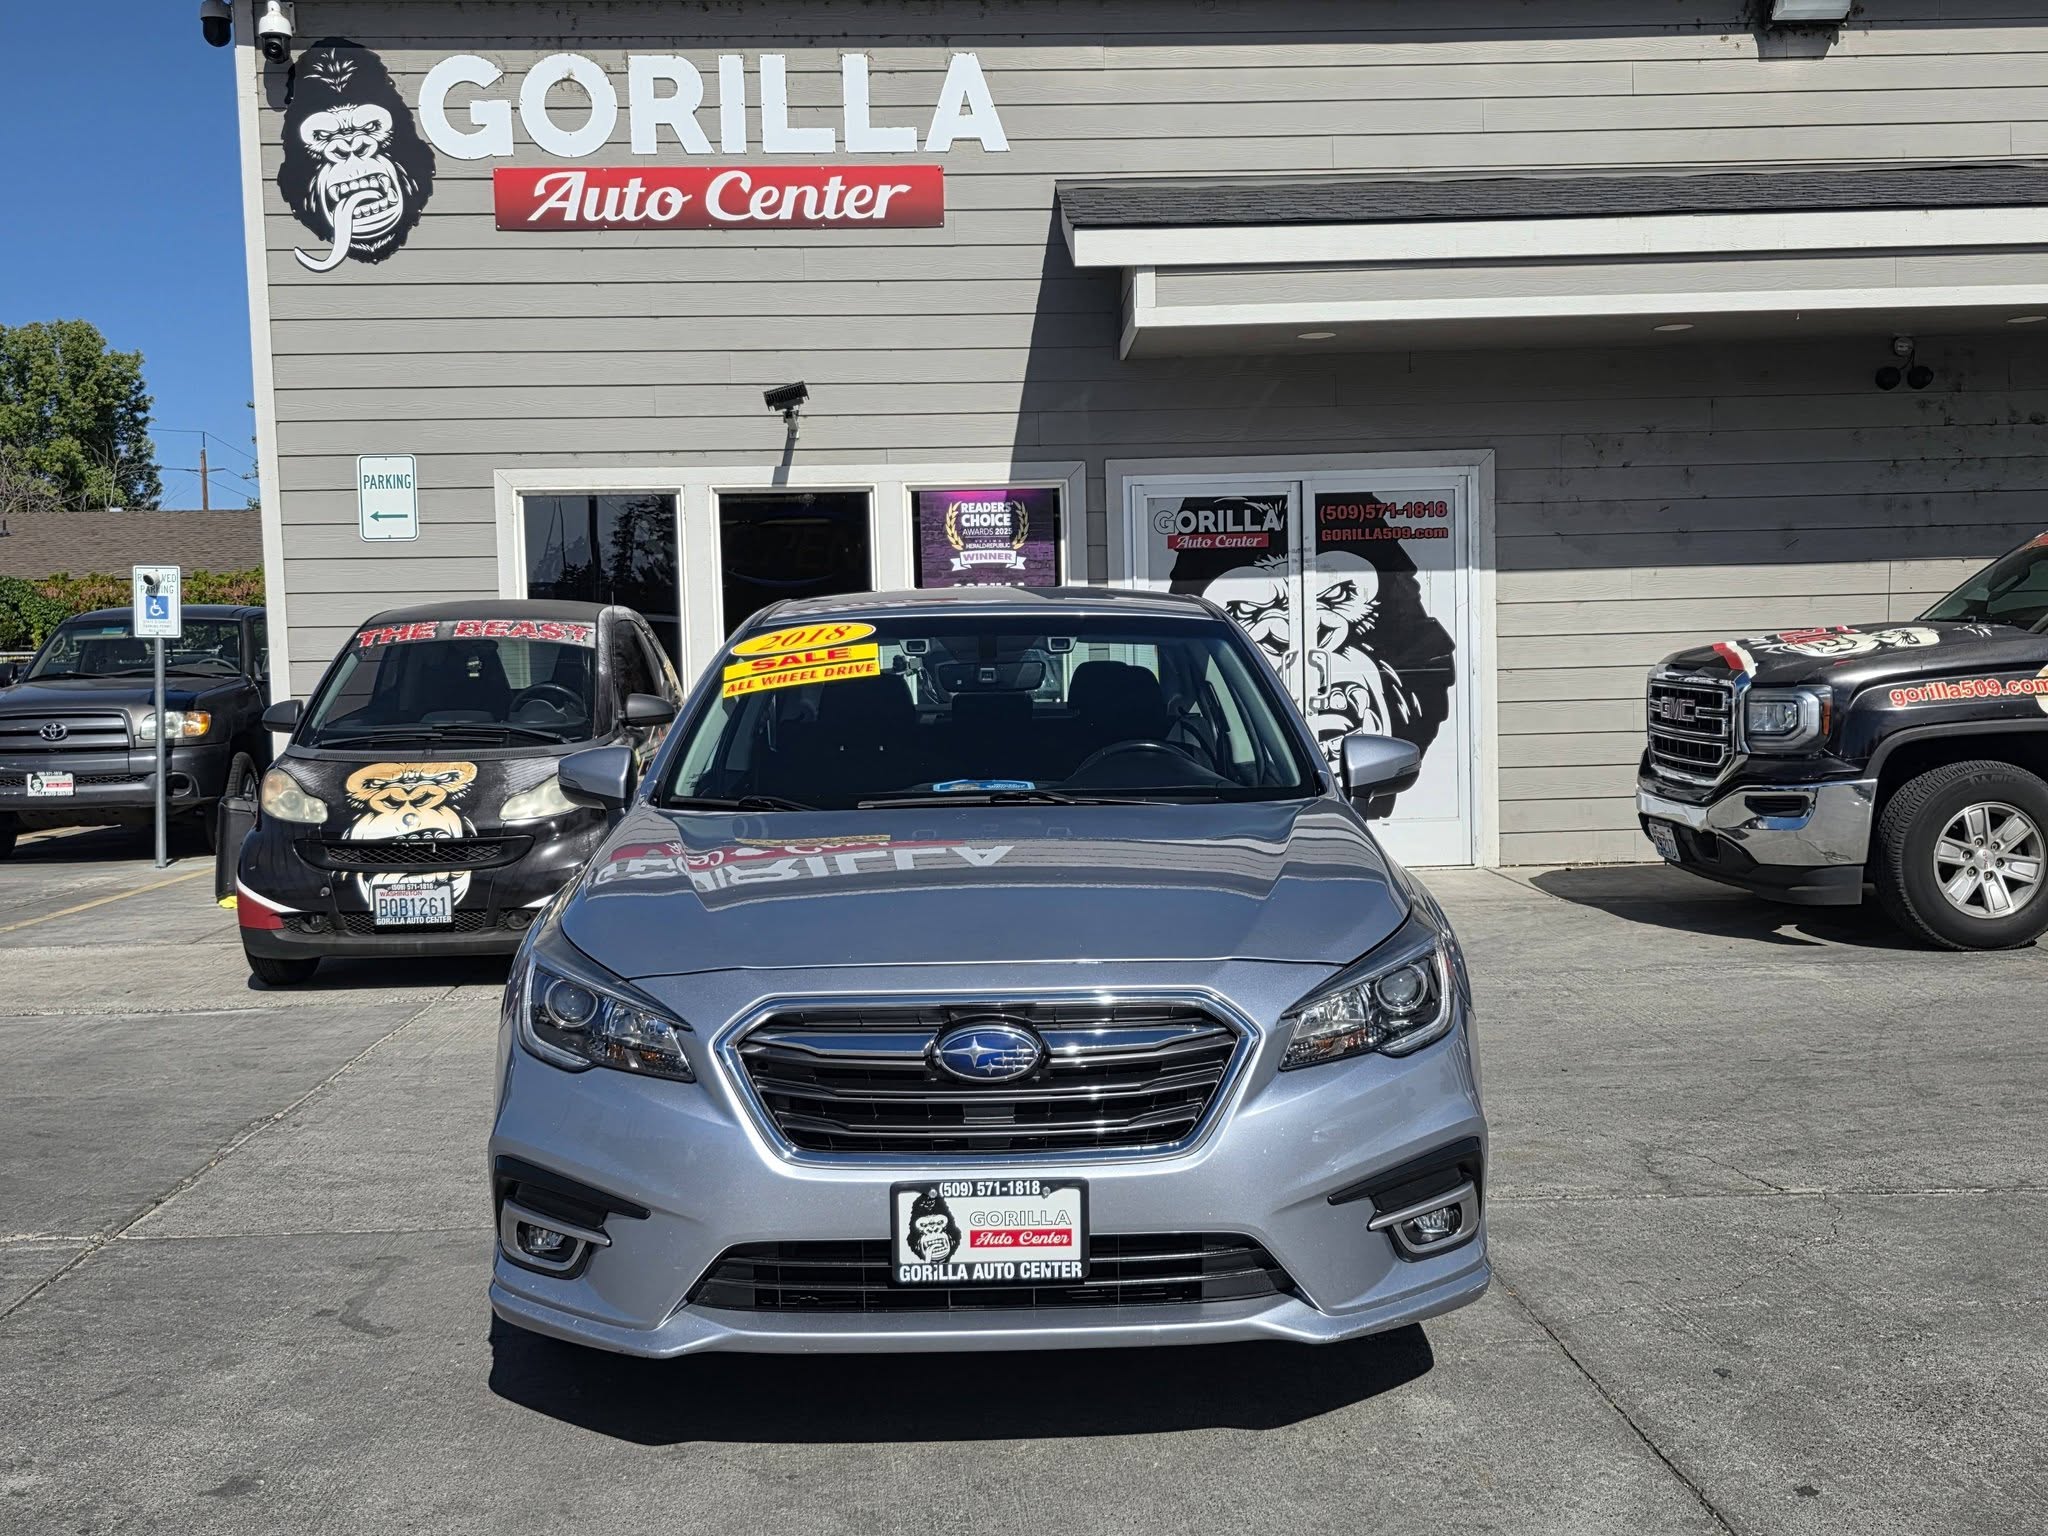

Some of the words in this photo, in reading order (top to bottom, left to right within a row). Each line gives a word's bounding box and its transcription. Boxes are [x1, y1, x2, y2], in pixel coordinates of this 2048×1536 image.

[419, 52, 1010, 159] GORILLA
[527, 171, 692, 222] Auto
[705, 170, 912, 222] Center
[363, 474, 411, 489] PARKING
[961, 514, 1012, 527] CHOICE
[1154, 510, 1281, 534] GORILLA
[1320, 501, 1448, 524] (509)571-1818
[962, 528, 994, 536] AWARDS
[995, 527, 1013, 535] 2025
[1176, 535, 1213, 548] Auto
[1215, 535, 1262, 547] Center
[1321, 526, 1448, 541] GORILLA509.com
[963, 552, 1012, 561] WINNER
[356, 621, 440, 648] THE
[453, 620, 595, 642] BEAST
[755, 625, 853, 652] 2018
[751, 647, 850, 672] SALE
[725, 680, 756, 695] ALL
[762, 669, 817, 687] WHEEL
[824, 662, 876, 677] DRIVE
[1889, 678, 2048, 707] gorilla509.com
[1661, 696, 1696, 721] GMC
[379, 897, 446, 917] BQB1261
[376, 917, 405, 926] GORILLA
[425, 916, 452, 924] CENTER
[939, 1181, 973, 1198] (509)
[977, 1180, 1040, 1197] 571-1818
[969, 1210, 1072, 1227] GORILLA
[974, 1231, 1014, 1246] Auto
[1019, 1231, 1070, 1246] Center
[900, 1263, 968, 1282] GORILLA
[973, 1262, 1015, 1280] AUTO
[1020, 1260, 1082, 1279] CENTER
